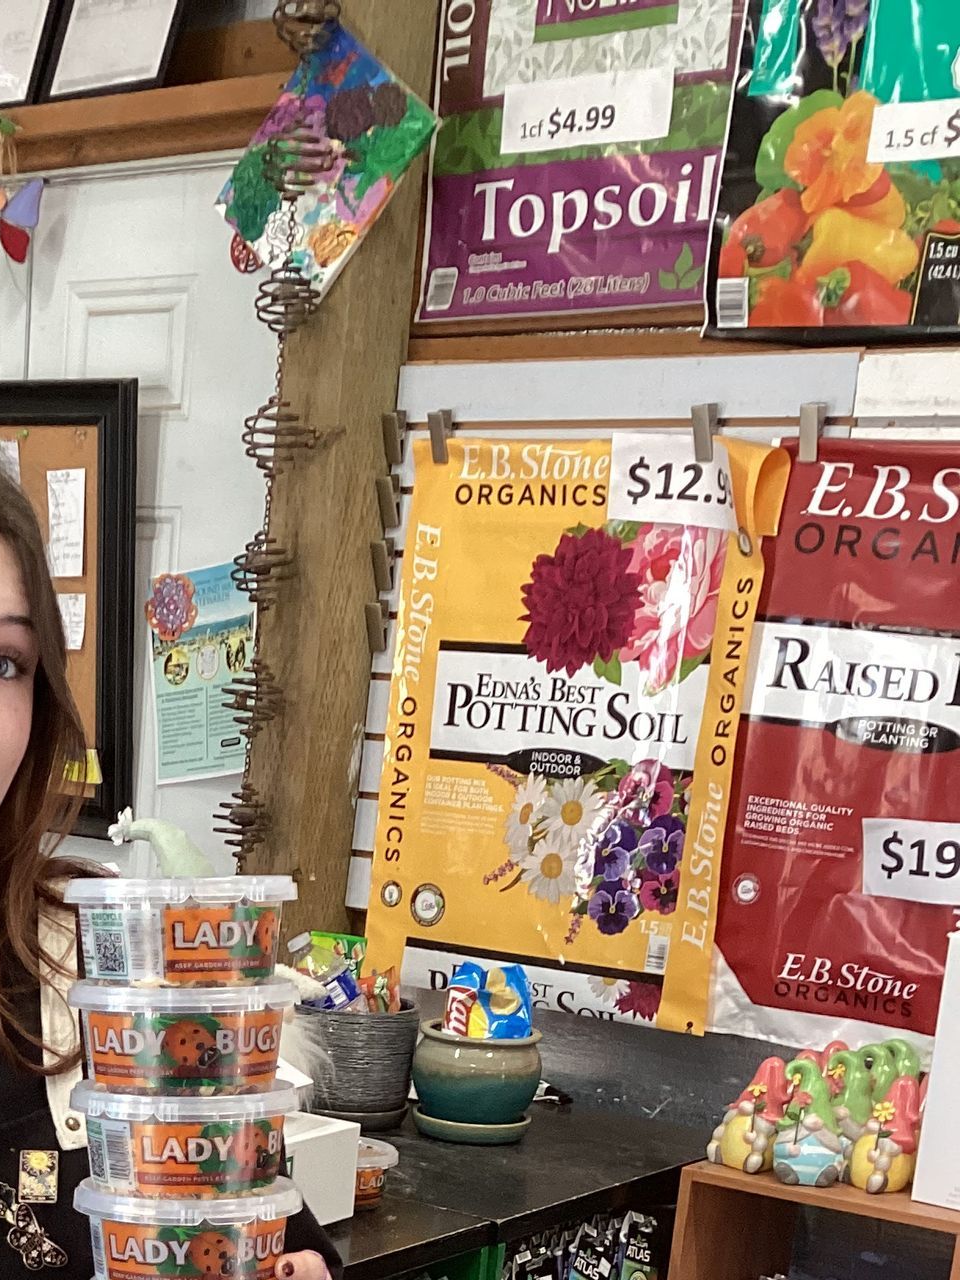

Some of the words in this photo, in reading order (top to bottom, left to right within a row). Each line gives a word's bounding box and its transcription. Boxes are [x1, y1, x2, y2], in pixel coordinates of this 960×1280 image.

[520, 119, 543, 140] 1cf
[548, 104, 616, 138] $4.99
[885, 129, 914, 149] 1.5
[920, 126, 938, 146] cf
[473, 154, 718, 253] Topsoil
[929, 241, 943, 259] 1.5
[486, 282, 530, 301] Cubic
[530, 279, 565, 299] Feet
[597, 273, 650, 292] Liters)
[455, 484, 607, 507] ORGANICS
[625, 457, 735, 508] $12.9
[710, 577, 754, 767] ORGANICS
[766, 636, 940, 704] RAISED
[475, 673, 542, 701] EDNA'S
[549, 677, 606, 705] BEST
[443, 682, 596, 739] POTTING
[602, 691, 689, 746] SOIL
[858, 719, 915, 737] POTTING
[919, 724, 939, 739] OR
[861, 732, 930, 748] PLANTING
[529, 762, 581, 775] OUTDOOR
[531, 751, 572, 765] INDOOR
[574, 754, 583, 765] &
[385, 696, 418, 863] ORGANICS
[746, 804, 804, 819] INGREDIENTS
[806, 812, 827, 821] FOR
[748, 795, 808, 811] EXCEPTIONAL
[810, 804, 854, 816] QUALITY
[744, 820, 774, 831] RAISED
[745, 812, 787, 825] GROWING
[789, 818, 834, 831] ORGANIC
[173, 921, 258, 950] LADY
[774, 980, 913, 1018] ORGANICS
[93, 1025, 167, 1056] LADY
[215, 1023, 279, 1056] BUGS
[142, 1135, 234, 1164] LADY
[109, 1233, 190, 1266] LADY
[238, 1230, 285, 1264] BUG
[626, 1245, 651, 1262] ATLAS
[573, 1256, 600, 1280] ATLAS
